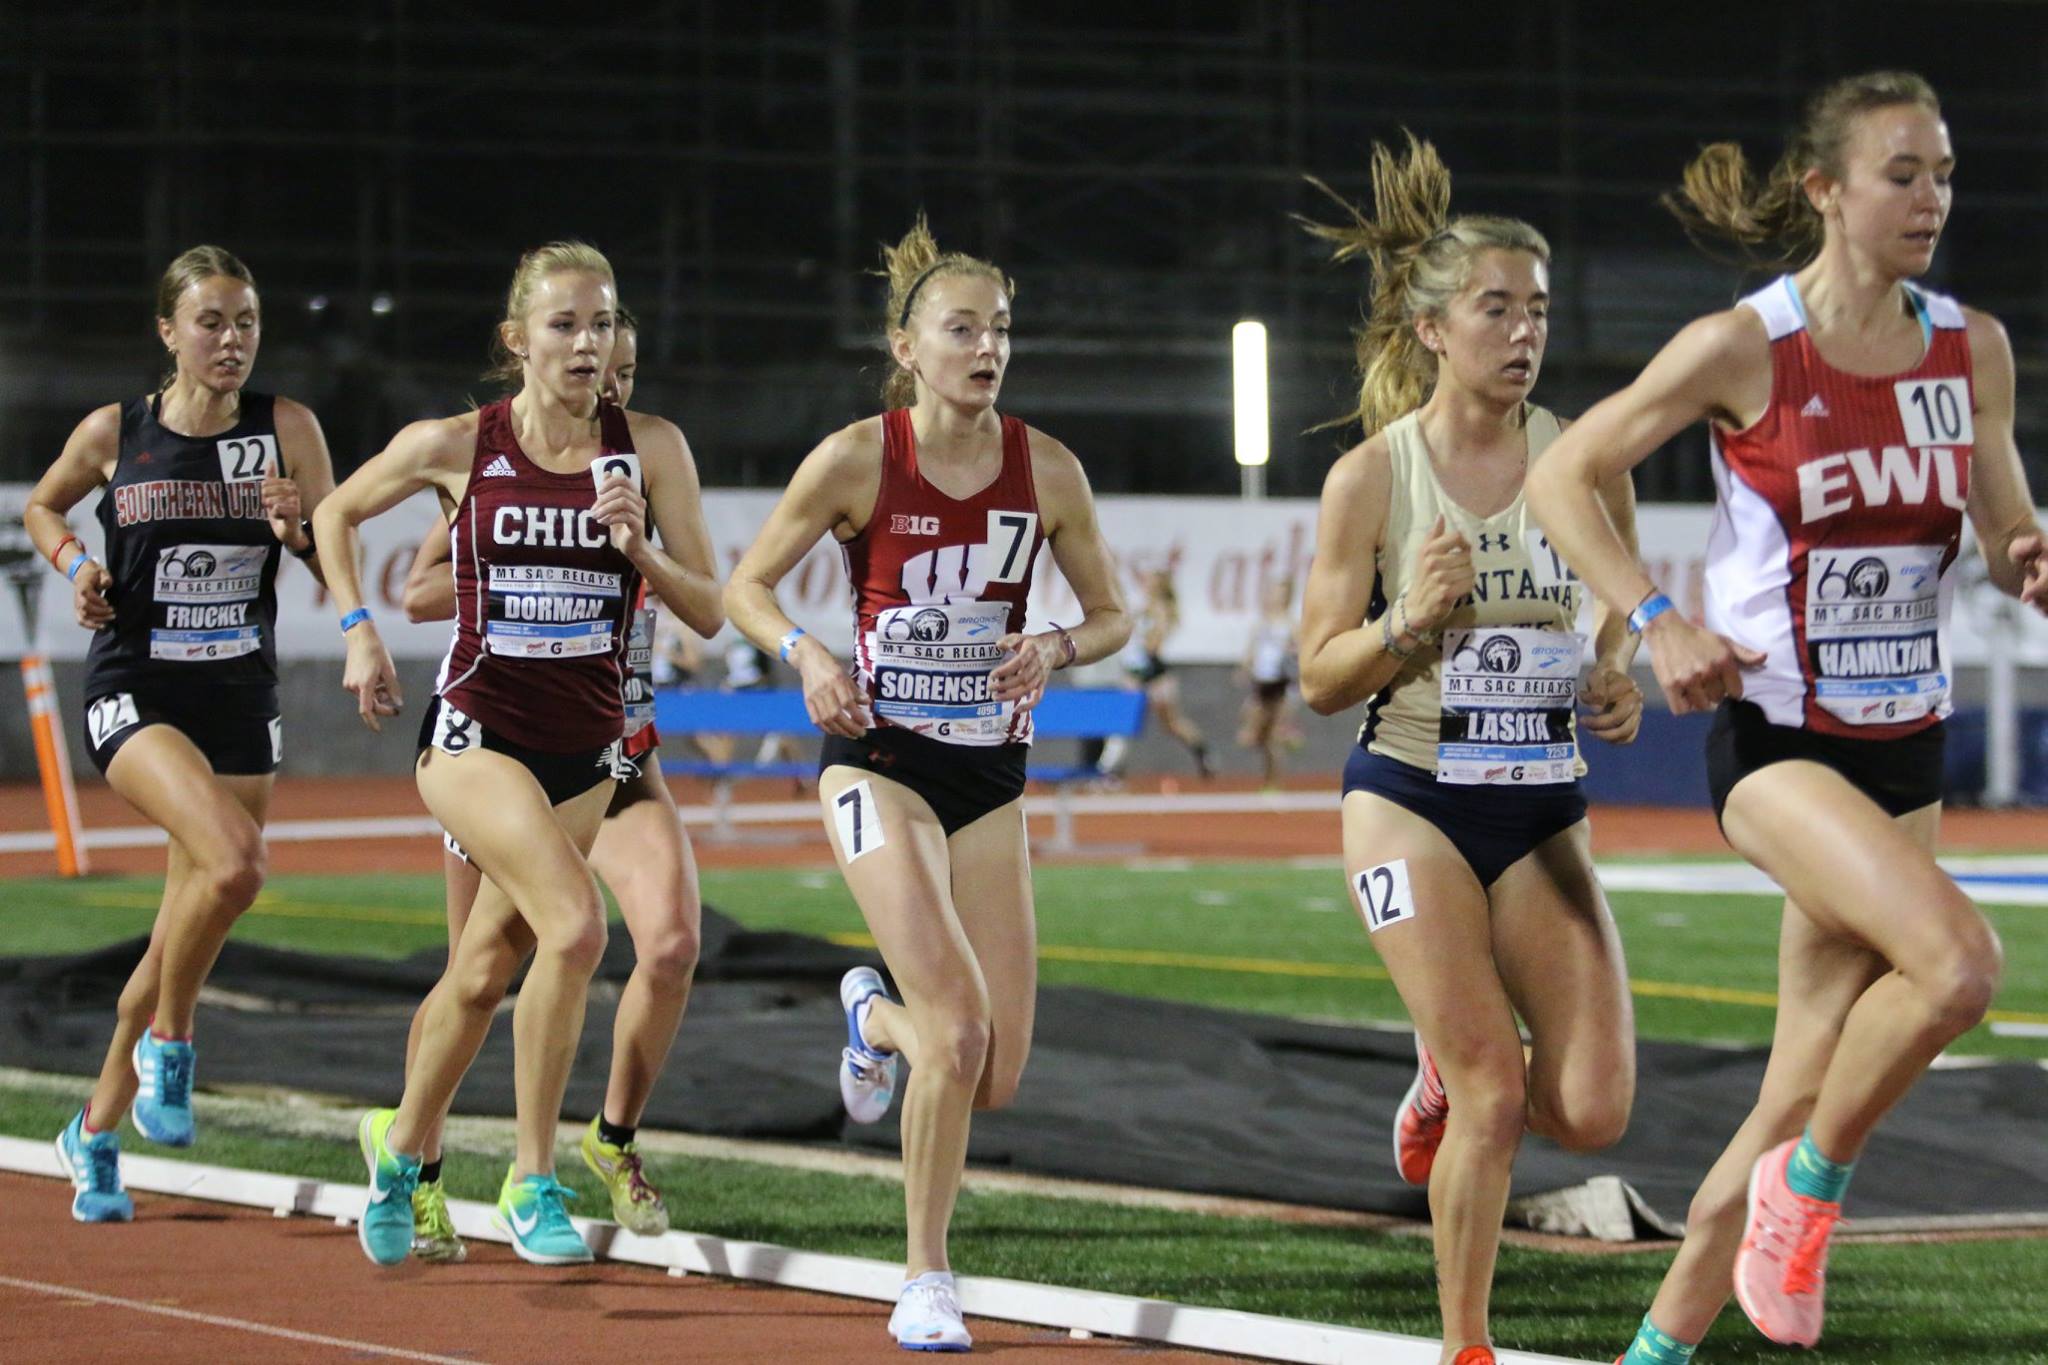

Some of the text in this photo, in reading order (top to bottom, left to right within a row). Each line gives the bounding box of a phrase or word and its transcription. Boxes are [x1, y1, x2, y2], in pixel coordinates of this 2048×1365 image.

[1911, 384, 1961, 441] 10
[227, 438, 265, 479] 22
[483, 469, 517, 478] adidas
[115, 480, 225, 527] SOUTHERN
[999, 516, 1028, 578] 7
[187, 582, 212, 592] SAC
[526, 567, 554, 580] SAC
[562, 570, 615, 586] RELAYS
[166, 602, 249, 628] FRUCHEY
[505, 595, 604, 621] DORMAN
[1852, 607, 1882, 621] SAC
[914, 646, 945, 659] SAC
[953, 645, 1001, 658] RELAYS
[1485, 679, 1516, 693] SAC
[1525, 680, 1572, 694] RELAYS
[91, 693, 127, 737] 22
[443, 706, 473, 756] 8
[838, 788, 862, 854] 7
[1360, 867, 1401, 926] 12
